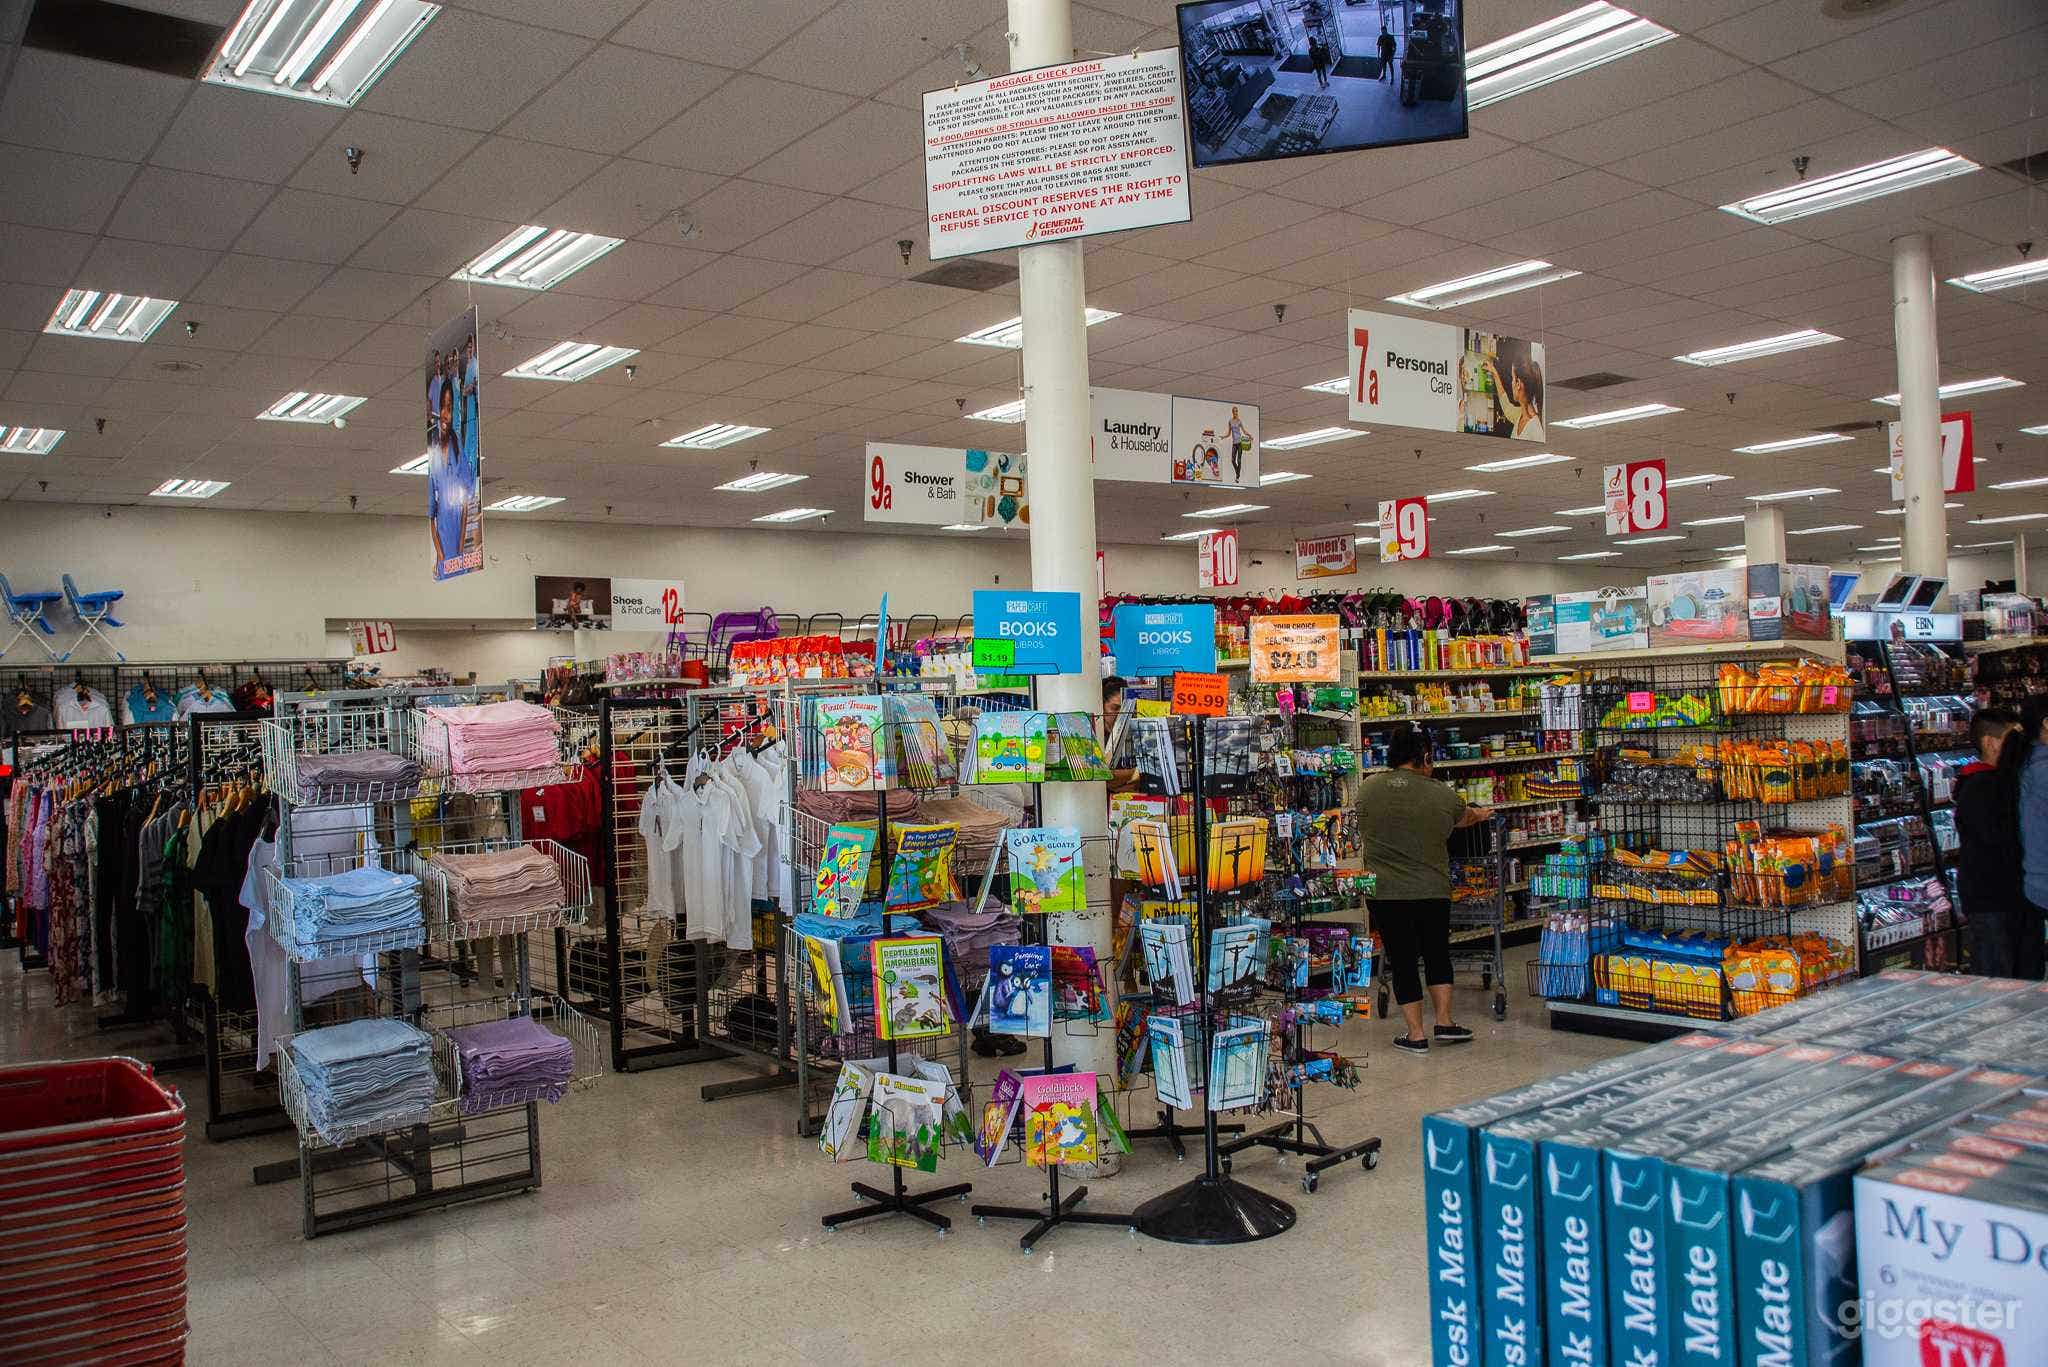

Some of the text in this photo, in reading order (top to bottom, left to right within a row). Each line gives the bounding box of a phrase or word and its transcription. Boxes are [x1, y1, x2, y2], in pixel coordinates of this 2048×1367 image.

[990, 63, 1101, 90] BAGGAGE CHECK POINT
[942, 139, 982, 150] ATTENTION
[1020, 128, 1045, 137] PLEASE
[1078, 118, 1101, 127] LEAVE
[1103, 114, 1123, 122] YOUR
[1125, 107, 1164, 118] CHILDREN
[965, 127, 994, 138] DRINKS
[1009, 116, 1054, 130] STROLLERS
[1057, 109, 1096, 121] ALLOWED
[1099, 103, 1128, 114] INSIDE
[1131, 100, 1147, 108] THE
[1148, 95, 1175, 105] STORE
[928, 148, 974, 161] UNATTENDED
[1022, 135, 1047, 144] ALLOW
[1050, 131, 1069, 140] THEM
[1083, 126, 1101, 134] PLAY
[1103, 120, 1135, 130] AROUND
[1136, 117, 1151, 125] THE
[1153, 112, 1180, 122] STORE.
[959, 155, 1000, 166] ATTENTION
[1050, 142, 1076, 150] PLEASE
[1110, 132, 1130, 140] OPEN
[932, 144, 1176, 191] SHOPLIFTING LAWS WILL BE STRICTLY ENFORCED.
[952, 166, 989, 176] PACKAGES
[1017, 156, 1042, 165] STORE.
[1045, 152, 1072, 160] PLEASE
[1108, 137, 1157, 150] ASSISTANCE.
[958, 188, 983, 197] PLEASE
[1041, 174, 1069, 183] PURSES
[1120, 160, 1152, 170] SUBJECT
[990, 190, 1017, 199] SEARCH
[1020, 186, 1042, 194] PRIOR
[1056, 178, 1087, 188] LEAVING
[1105, 171, 1131, 180] STORE.
[931, 175, 1181, 222] GENERAL DISCOUNT RESERVES THE RIGHT TO
[940, 188, 1173, 232] REFUSE SERVICE TO ANYONE AT ANY TIME
[1039, 217, 1083, 229] GENERAL
[1040, 225, 1085, 237] DISCOUNT
[1354, 328, 1379, 406] 7a
[1386, 351, 1448, 376] Personal
[1430, 376, 1452, 396] Care
[1104, 418, 1161, 440] Laundry
[1111, 435, 1168, 454] & Household
[871, 455, 892, 511] 9a
[904, 470, 955, 487] Shower
[927, 487, 956, 500] & Bath
[1631, 466, 1664, 530] 8
[1400, 502, 1426, 559] 9
[1214, 535, 1237, 586] 10
[1298, 538, 1347, 557] Women's
[1316, 553, 1343, 565] Clothing
[612, 596, 643, 605] Shoes
[621, 606, 661, 615] & Foot Care
[662, 588, 684, 625] 12a
[364, 621, 395, 652] 15
[999, 621, 1057, 636] BOOKS
[1138, 630, 1192, 645] BOOKS
[1015, 640, 1045, 649] LIBROS
[1152, 648, 1180, 656] LIBROS
[847, 700, 878, 712] Treasure
[1176, 692, 1225, 708] $9.99
[1014, 834, 1046, 848] GOAT
[1047, 842, 1075, 850] GLOATS
[883, 947, 936, 957] REPTILES AND
[885, 956, 937, 967] AMPHIBIANS
[1014, 952, 1043, 961] Penguins
[1037, 1082, 1084, 1094] Goldilocks
[1438, 1188, 1466, 1288] Mate
[1880, 1197, 1964, 1260] My
[1496, 1203, 1525, 1307] Mate
[1560, 1216, 1591, 1322] Mate
[1623, 1226, 1657, 1337] Mate
[1880, 1264, 1896, 1285] 6
[1683, 1245, 1720, 1360] Mate
[1755, 1258, 1793, 1367] Mate
